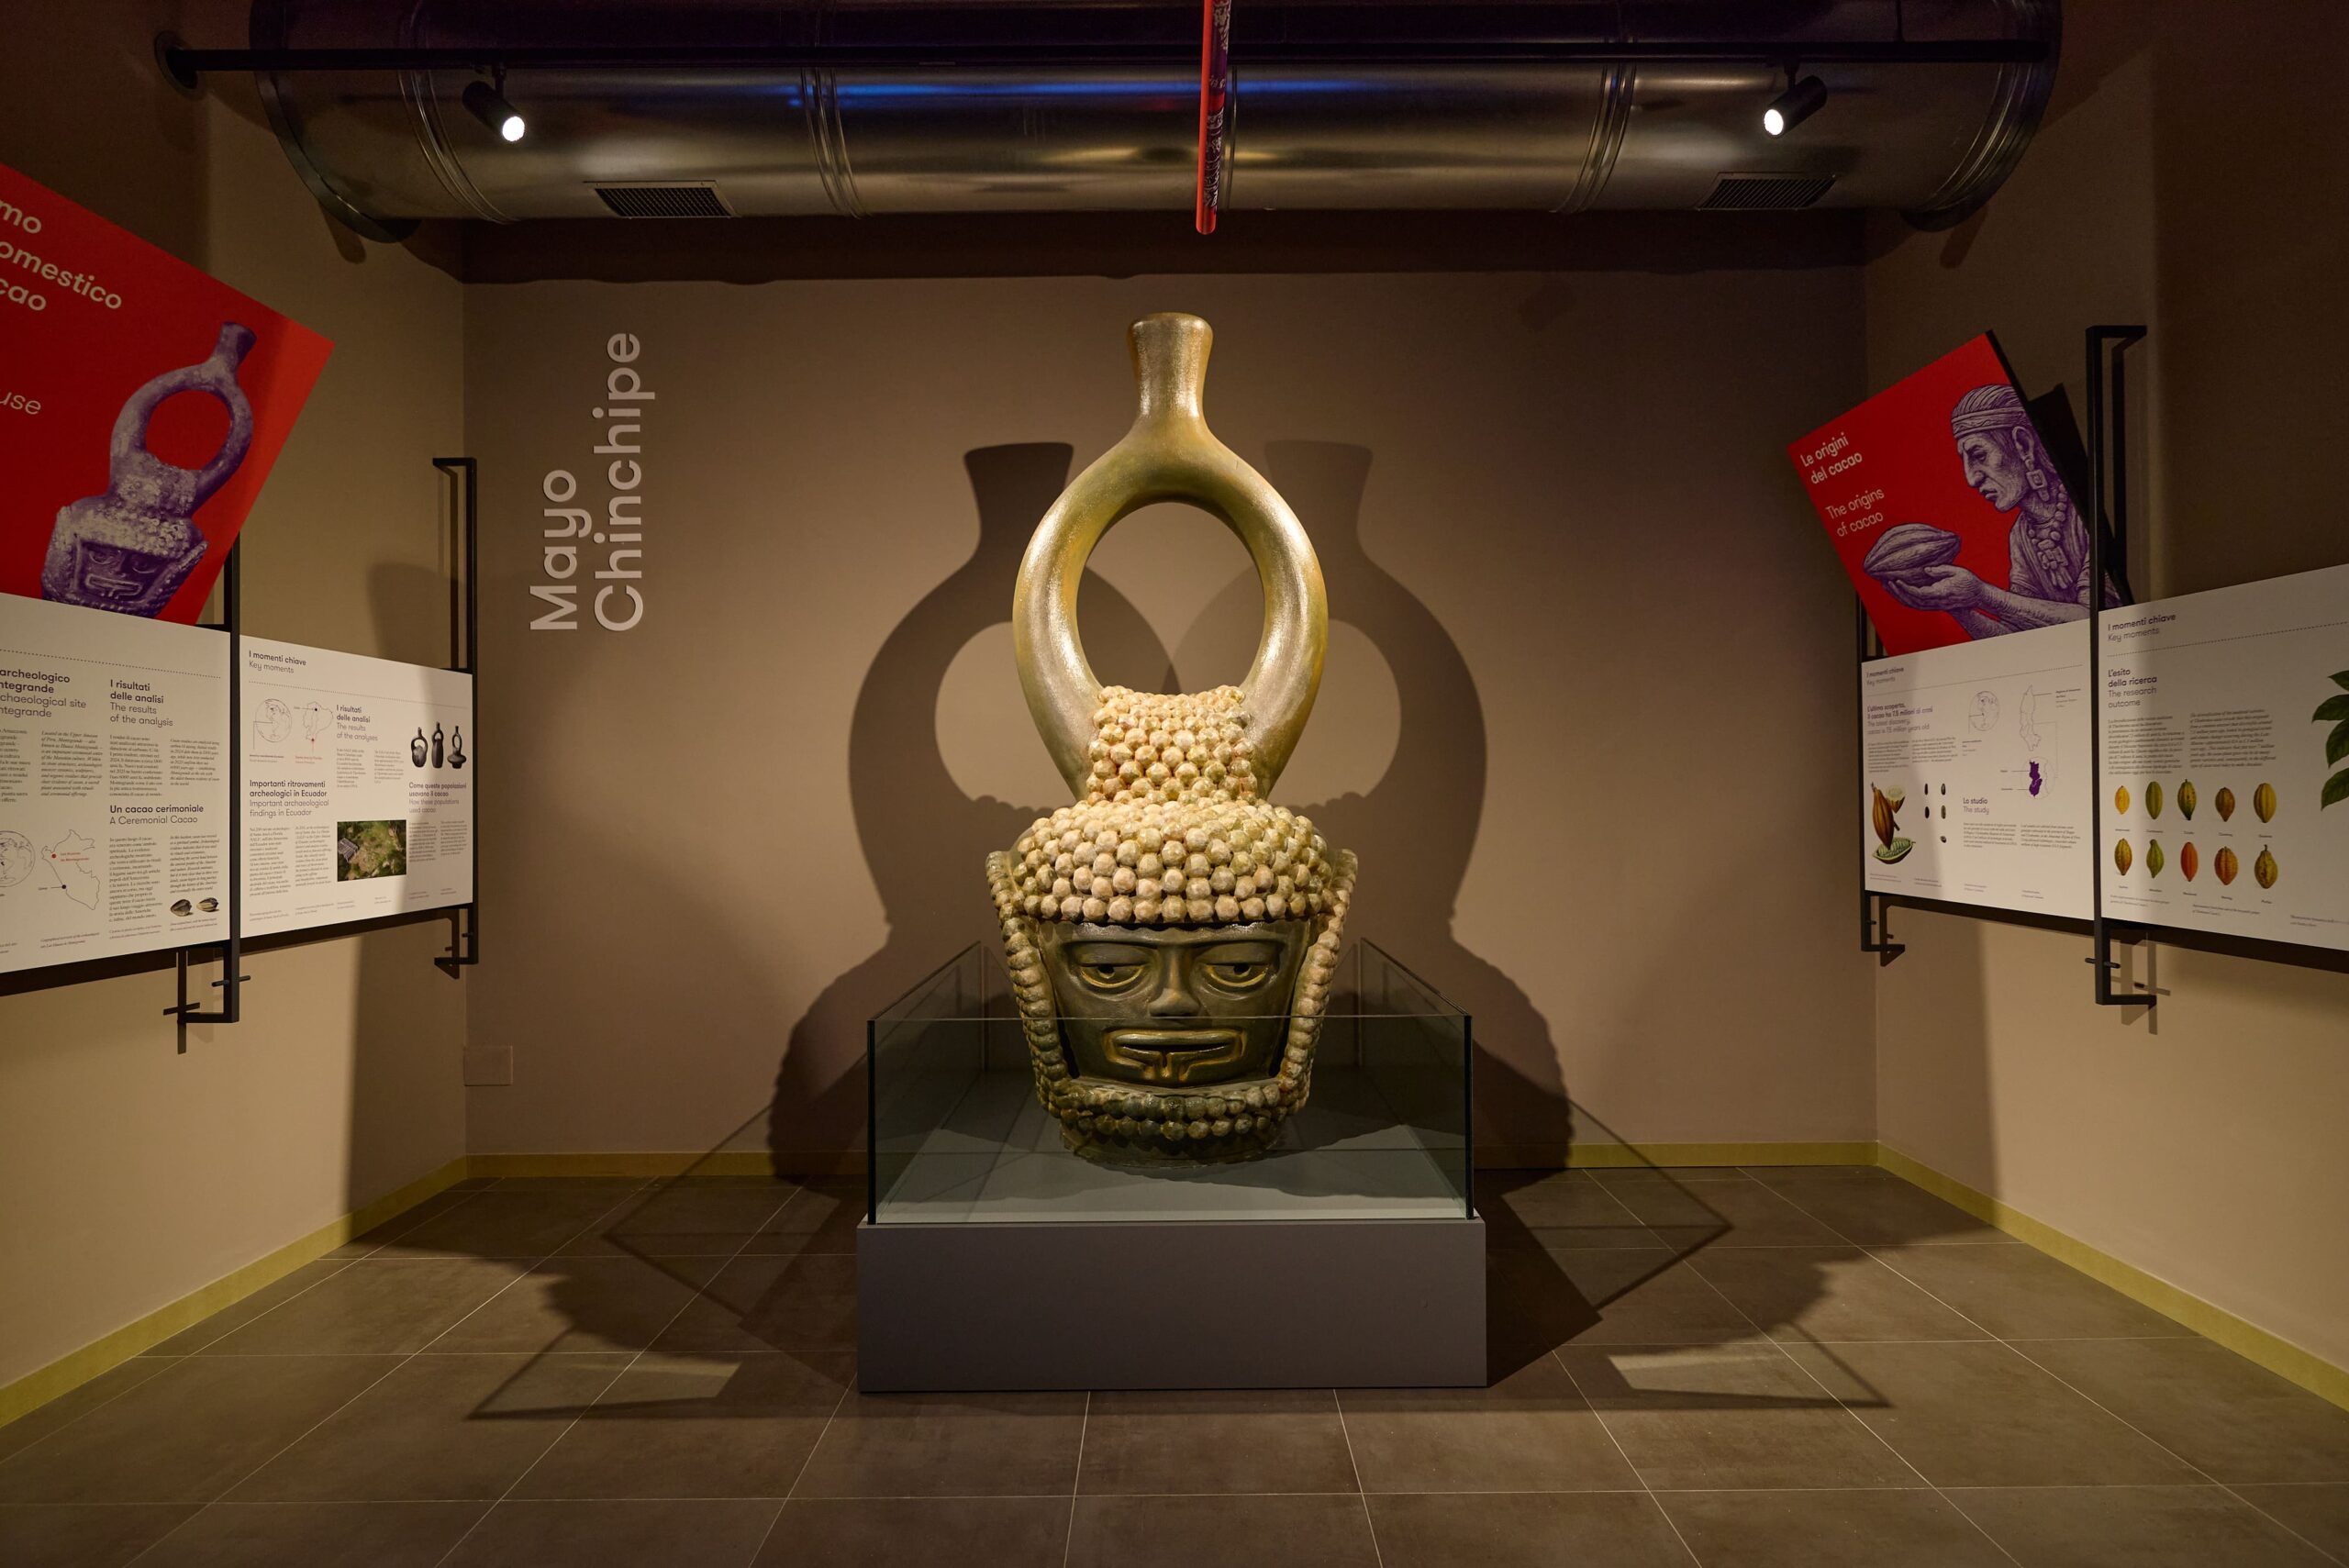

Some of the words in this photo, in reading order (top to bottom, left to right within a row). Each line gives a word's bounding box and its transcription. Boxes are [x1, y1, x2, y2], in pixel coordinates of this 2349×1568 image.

[1800, 454, 1814, 467] Le
[1815, 431, 1849, 460] origini
[1811, 466, 1828, 484] del
[1829, 452, 1863, 476] cacao
[592, 333, 655, 631] Chinchipe
[1825, 505, 1847, 520] The
[1848, 488, 1885, 511] origins
[1837, 521, 1848, 537] of
[1850, 512, 1883, 532] cacao
[529, 469, 592, 630] Mayo
[2112, 617, 2147, 630] momenti
[2148, 614, 2176, 625] chiave
[2108, 633, 2121, 643] Key
[2123, 628, 2160, 639] moments
[253, 652, 284, 663] momenti
[284, 655, 306, 666] chiave
[249, 660, 262, 672] Key
[264, 663, 295, 674] moments
[0, 669, 71, 684] archeologico
[2108, 679, 2127, 687] della
[2129, 676, 2157, 686] ricerca
[116, 680, 150, 691] risultati
[110, 692, 132, 701] delle
[135, 695, 164, 705] analisi
[2108, 689, 2121, 698] The
[2123, 687, 2157, 696] research
[70, 699, 87, 709] site
[110, 702, 127, 712] The
[128, 706, 157, 715] results
[340, 706, 362, 714] risultati
[110, 714, 119, 723] of
[122, 715, 137, 725] the
[139, 717, 174, 728] analysis
[337, 713, 351, 721] delle
[250, 780, 285, 789] Importanti
[288, 780, 326, 788] ritrovamenti
[250, 789, 292, 799] archeologici
[250, 799, 283, 808] Important
[284, 799, 329, 808] archaeological
[1963, 796, 1969, 805] Lo
[1970, 796, 1988, 806] studio
[110, 805, 122, 814] Un
[125, 806, 153, 814] cacao
[156, 804, 204, 813] cerimoniale
[250, 808, 277, 818] findings
[286, 808, 312, 817] Ecuador
[109, 816, 116, 824] A
[118, 815, 168, 825] Ceremonial
[171, 815, 198, 824] Cacao
